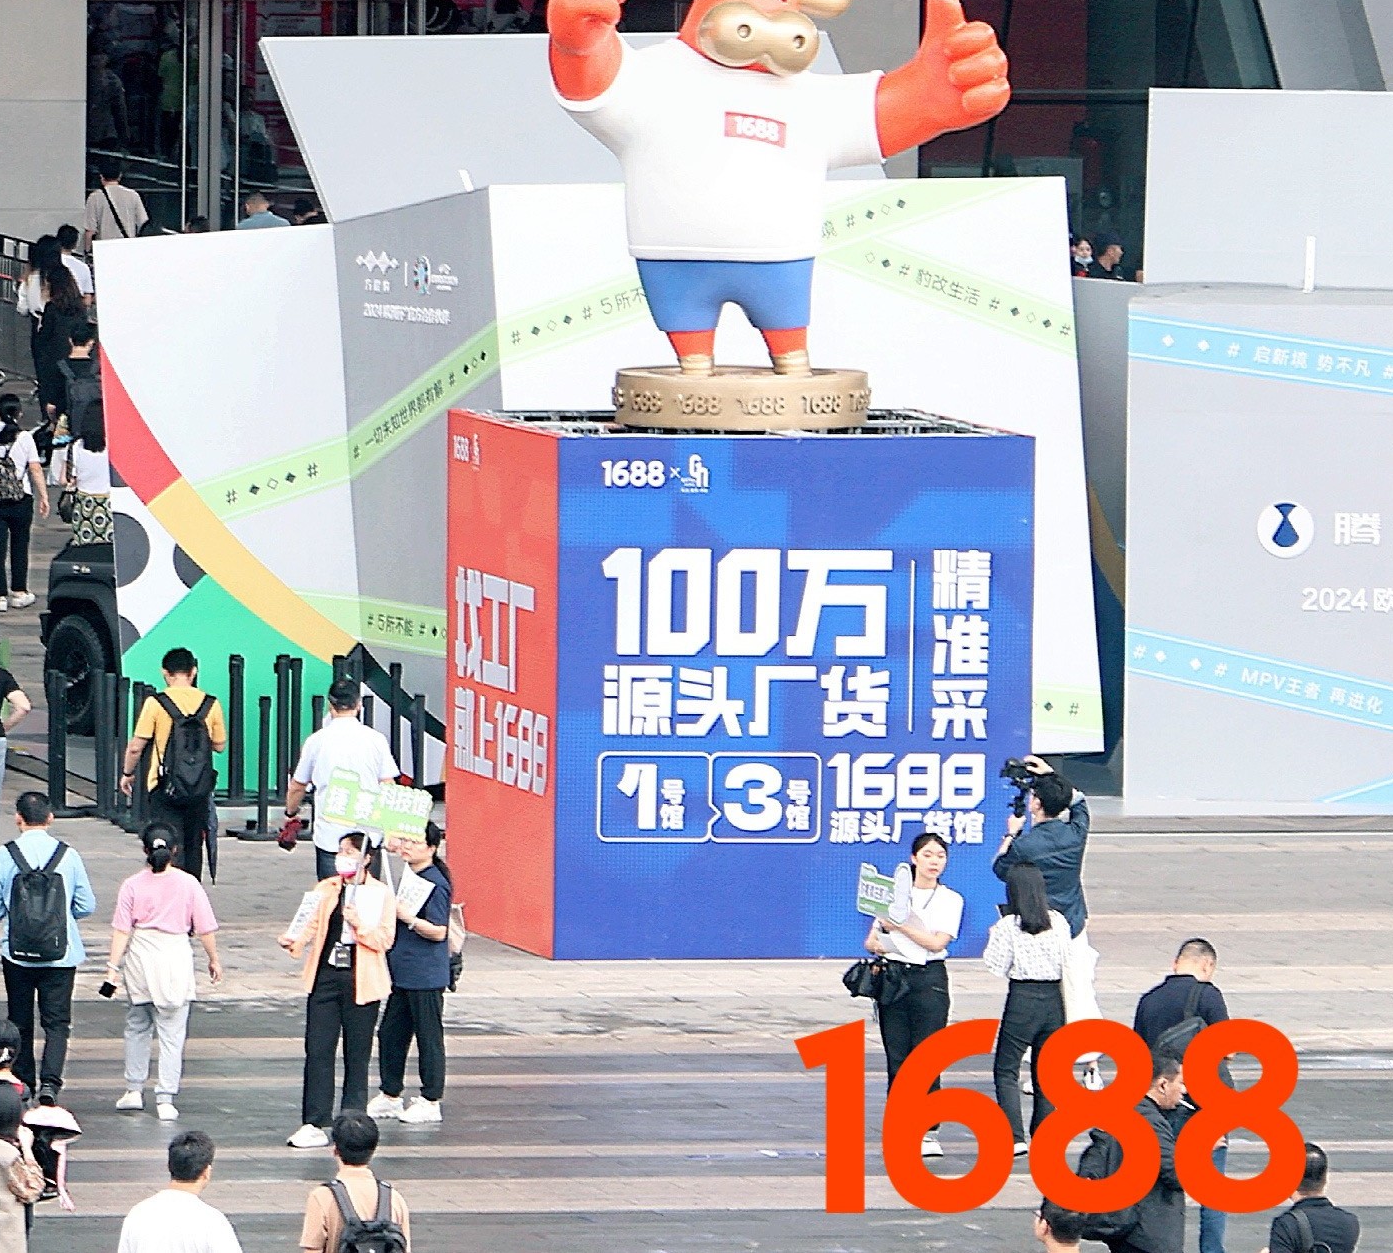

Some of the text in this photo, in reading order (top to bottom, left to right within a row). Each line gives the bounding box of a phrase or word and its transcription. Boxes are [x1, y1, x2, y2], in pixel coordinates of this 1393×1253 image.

[735, 116, 779, 142] 1688
[916, 268, 981, 306] 豹改生活
[601, 459, 666, 487] 1688
[1334, 511, 1382, 546] 腾
[601, 547, 894, 657] 100万
[455, 565, 535, 694] 找工厂
[931, 549, 992, 740] 精准采
[603, 664, 892, 738] 源头厂货
[1241, 665, 1322, 701] MPV王者
[454, 686, 549, 797] 就上1688
[828, 753, 986, 810] 1688
[829, 810, 985, 844] 源头厂货馆
